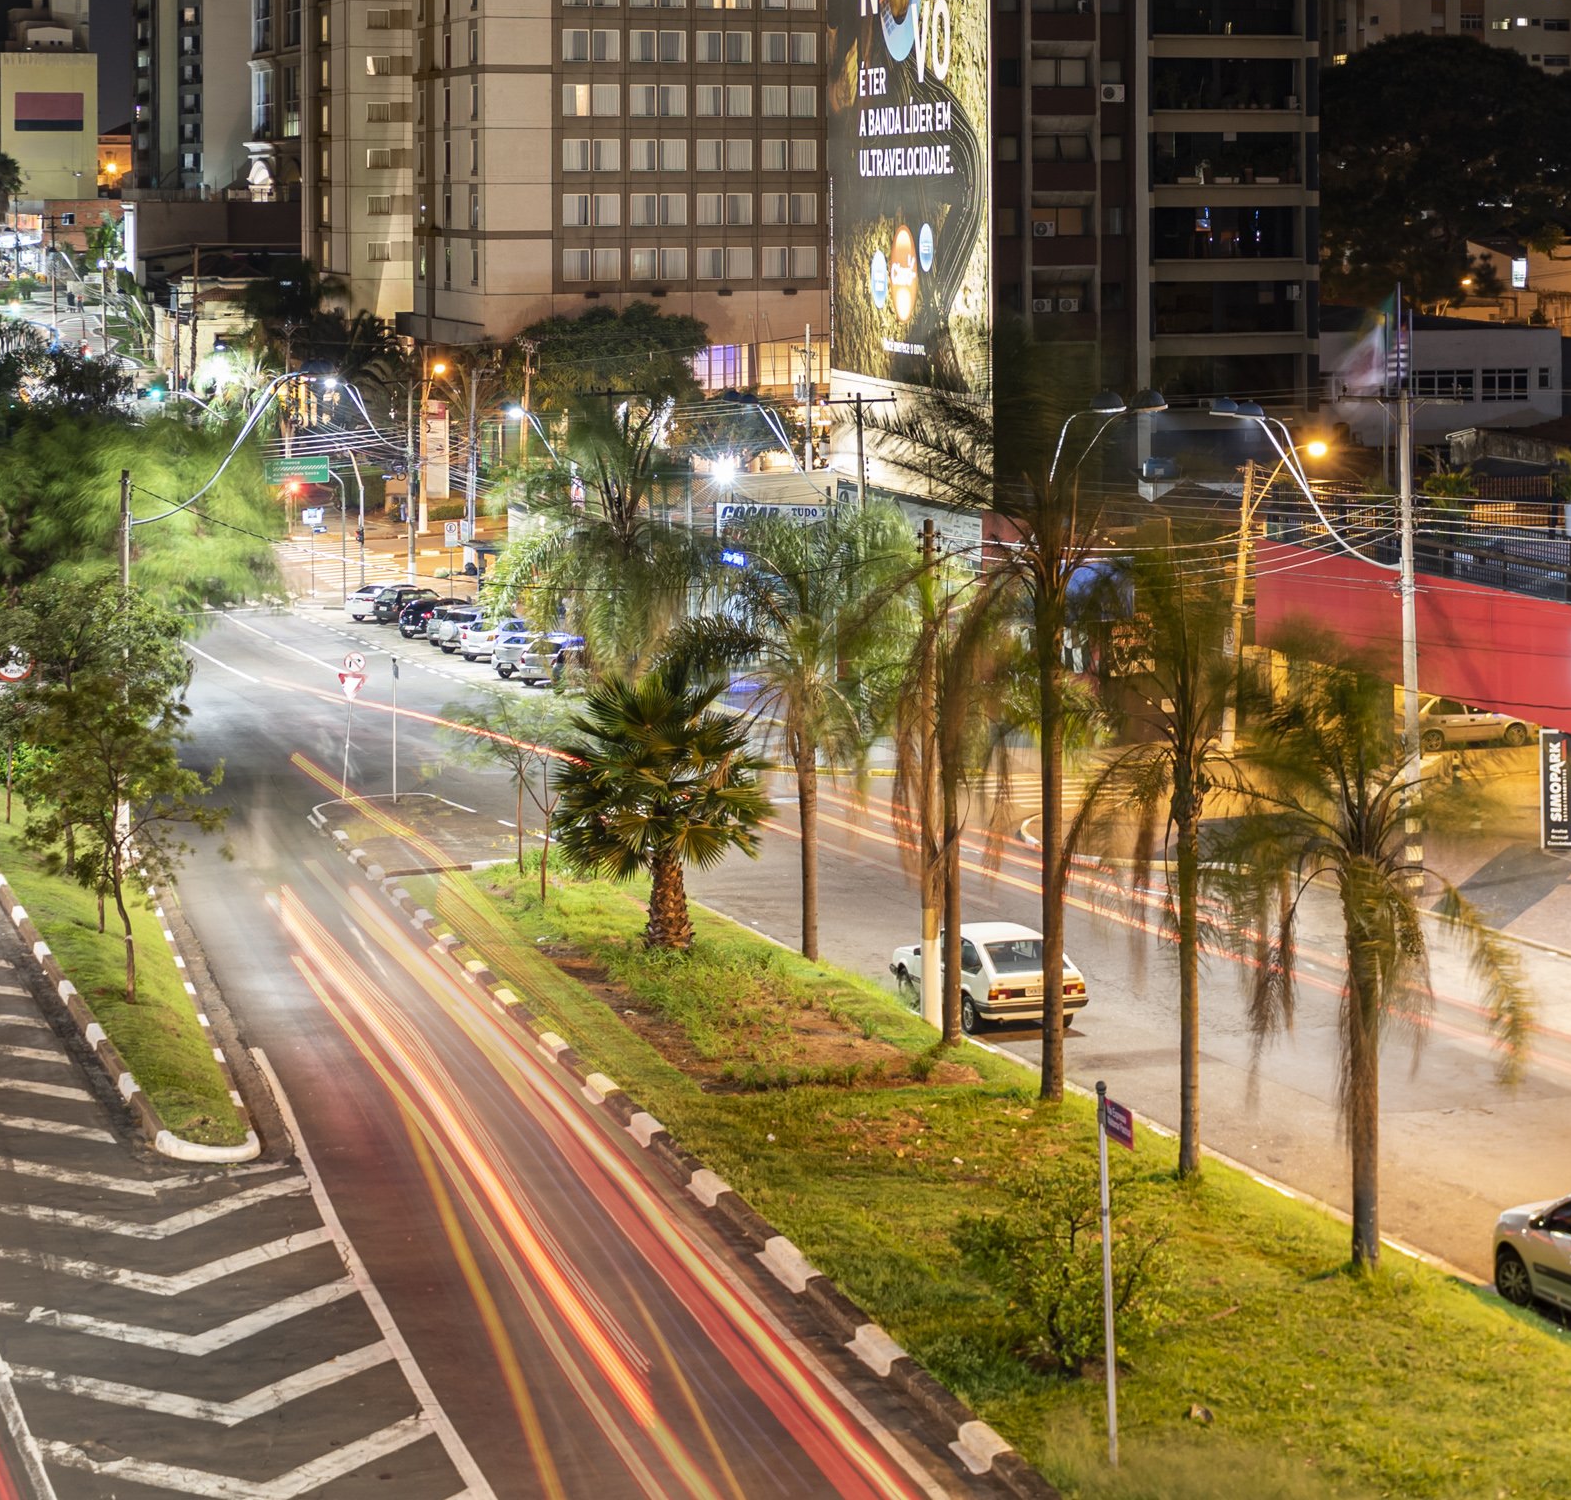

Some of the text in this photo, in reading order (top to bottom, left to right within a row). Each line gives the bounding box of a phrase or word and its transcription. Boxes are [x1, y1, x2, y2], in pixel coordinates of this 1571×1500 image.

[859, 62, 887, 97] É TER
[859, 96, 952, 137] A BANDA LÍDER EM
[859, 145, 955, 177] ULTRAVELOCIDADE.
[791, 507, 818, 517] TUDO
[1549, 741, 1565, 822] SIMOPARK
